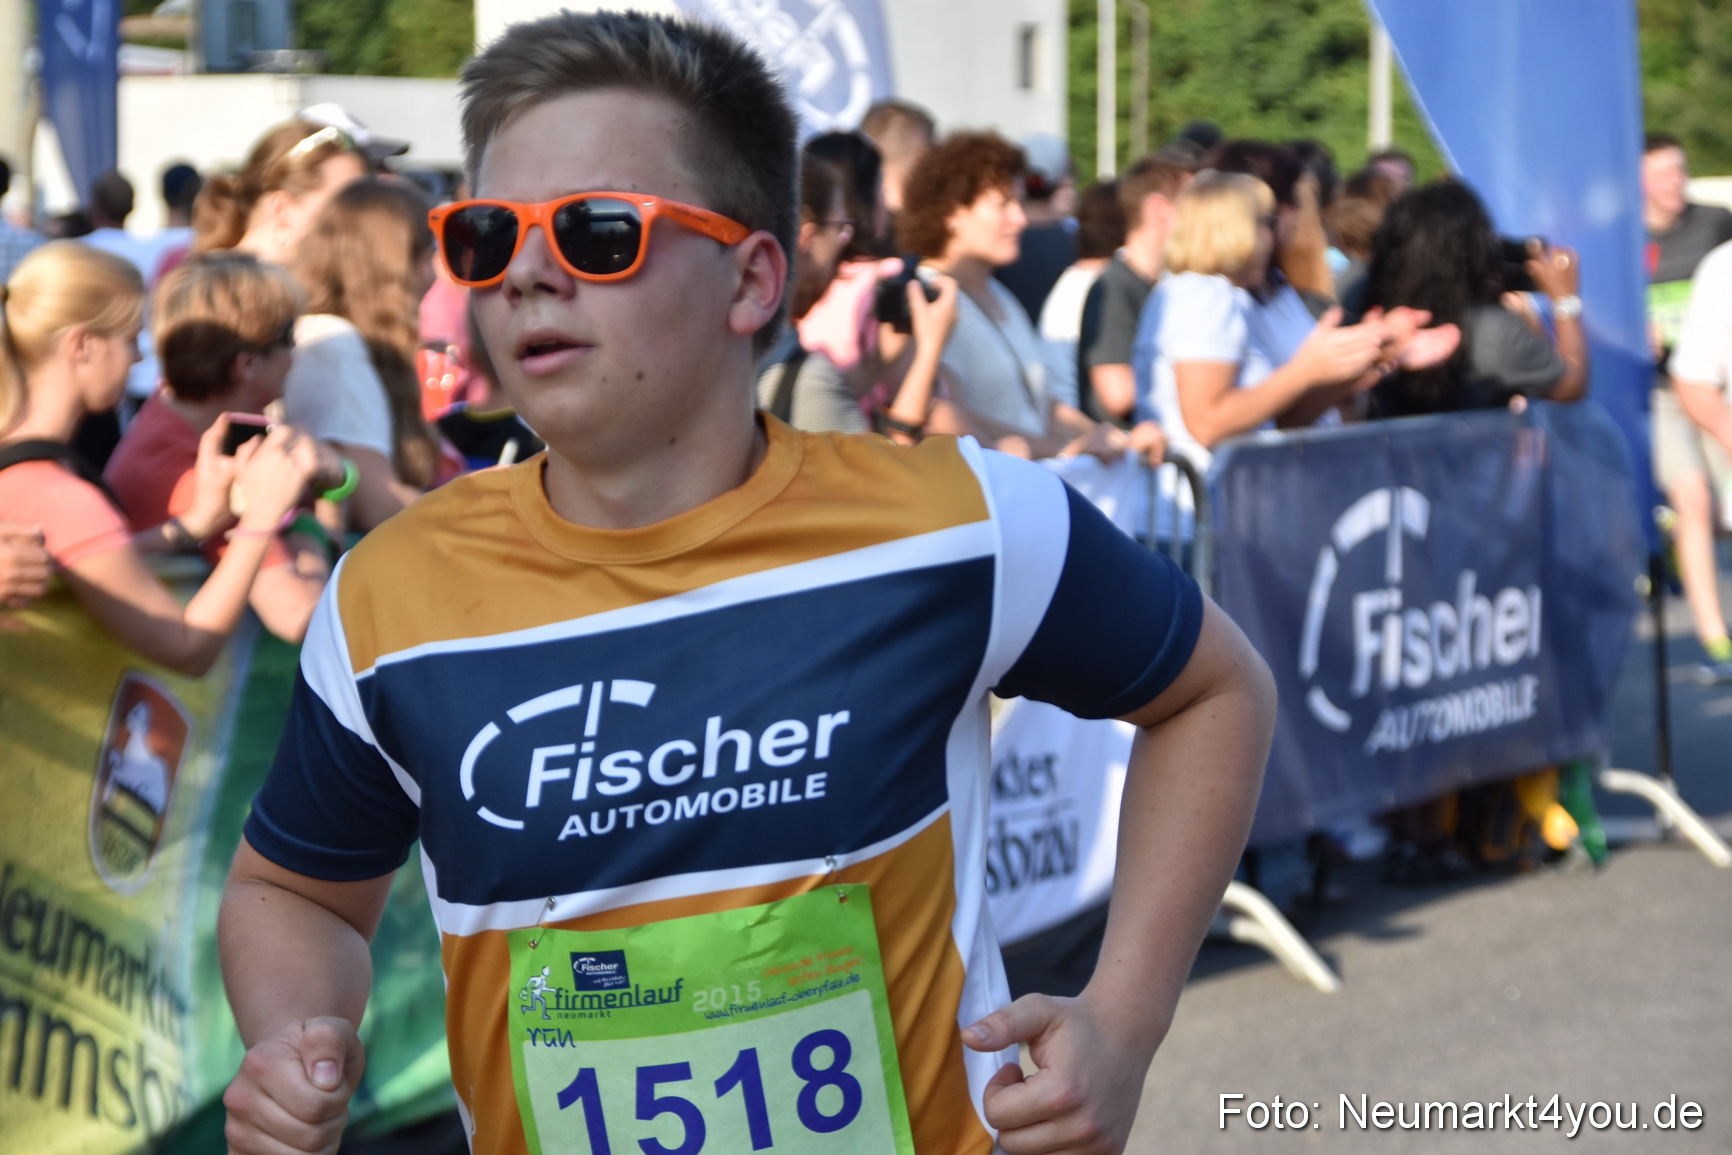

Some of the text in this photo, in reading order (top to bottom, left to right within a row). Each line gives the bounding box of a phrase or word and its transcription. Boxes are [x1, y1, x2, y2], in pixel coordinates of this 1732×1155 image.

[1363, 674, 1538, 756] AUTOMOBILE
[525, 710, 851, 808] Fischer
[557, 772, 828, 841] AUTOMOBILE
[581, 962, 619, 972] Fischer
[555, 978, 684, 1010] firmenlauf
[556, 1010, 612, 1020] neumarkt
[692, 980, 762, 1013] 2015
[704, 972, 861, 1020] www.firmenlauf-oberpfalz.de
[556, 1029, 863, 1155] 1518
